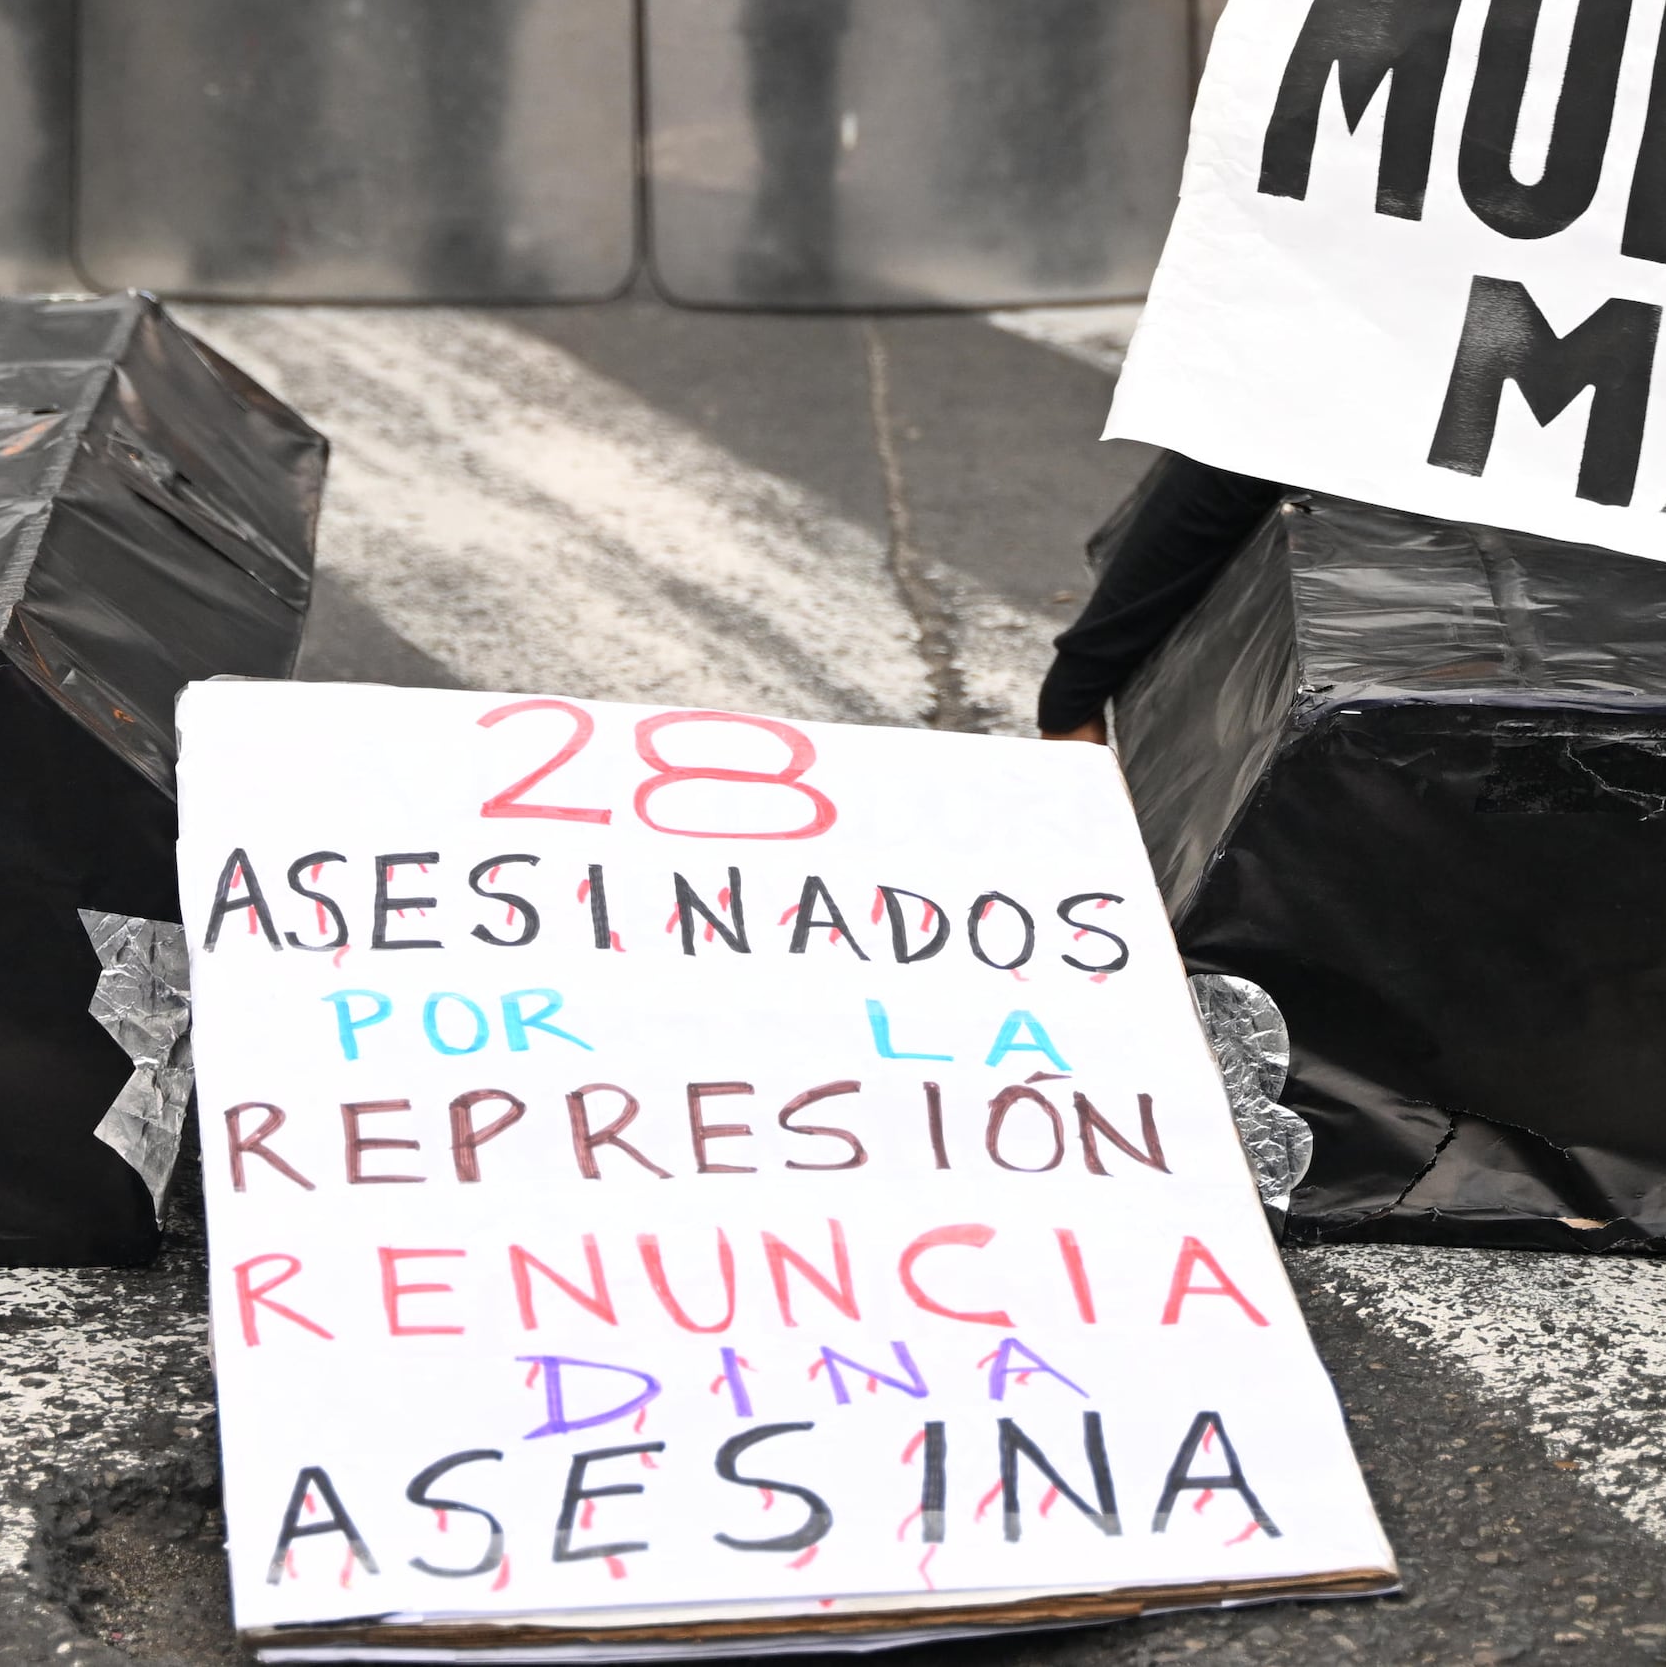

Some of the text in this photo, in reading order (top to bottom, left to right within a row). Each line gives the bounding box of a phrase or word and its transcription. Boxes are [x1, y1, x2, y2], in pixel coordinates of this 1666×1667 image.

[476, 697, 838, 841] 28
[203, 845, 1131, 974] ASESINADOS
[321, 987, 1074, 1072] POR LA
[222, 1070, 1173, 1193] REPRESIÓN
[231, 1218, 1271, 1348] RENUNCIA
[514, 1336, 1090, 1440] DINA
[264, 1409, 1284, 1586] ASESINA
